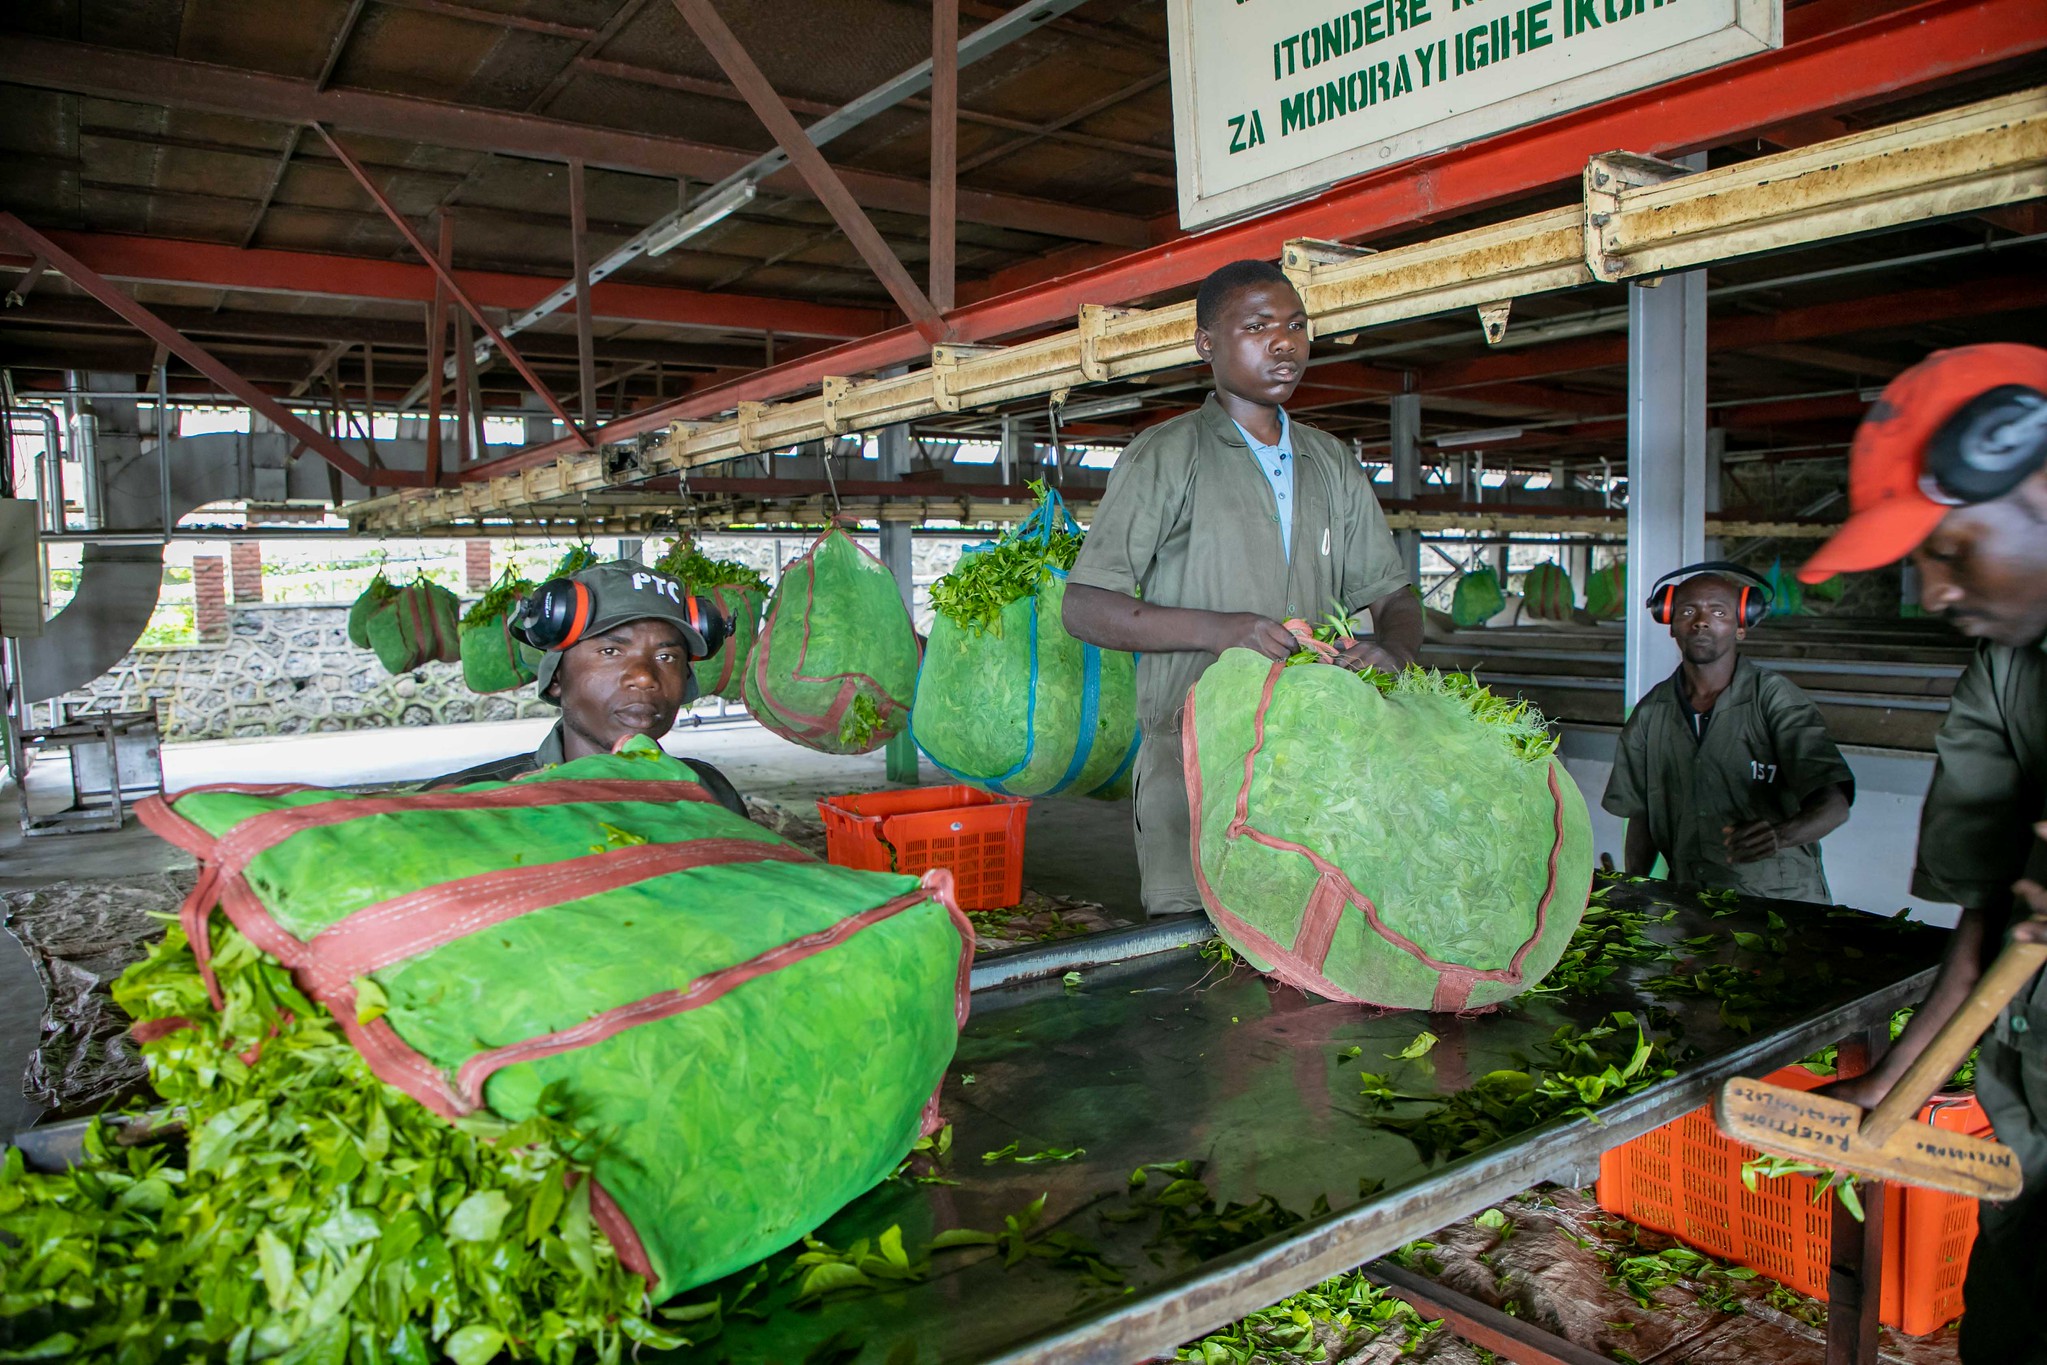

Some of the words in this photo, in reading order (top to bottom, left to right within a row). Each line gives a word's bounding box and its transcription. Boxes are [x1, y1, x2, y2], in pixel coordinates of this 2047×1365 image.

[1273, 0, 1432, 81] ITONDERE
[1227, 109, 1266, 155] ZA
[1280, 38, 1446, 137] MONORAYI
[1455, 0, 1553, 77] IGIHE
[632, 572, 681, 604] PTC
[1750, 760, 1778, 784] 157
